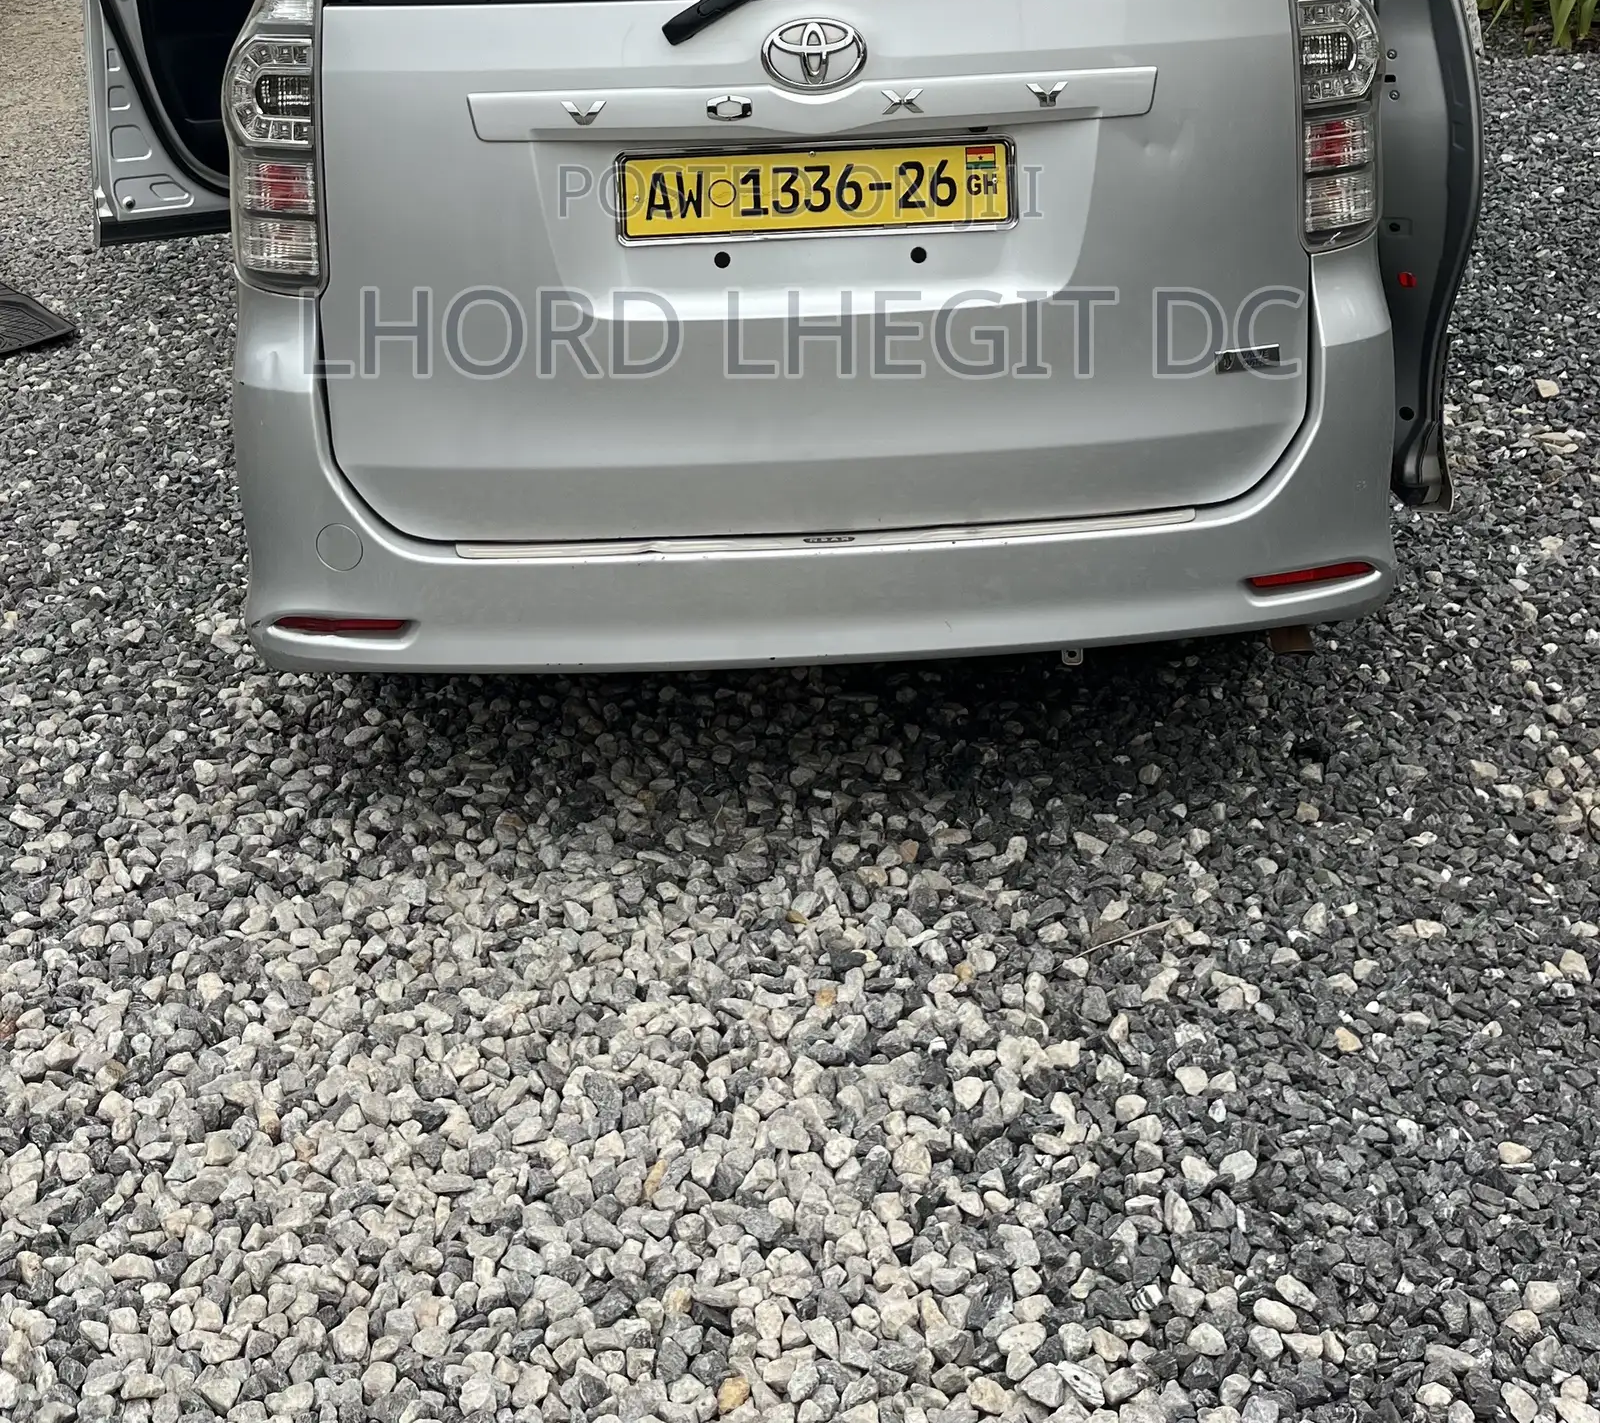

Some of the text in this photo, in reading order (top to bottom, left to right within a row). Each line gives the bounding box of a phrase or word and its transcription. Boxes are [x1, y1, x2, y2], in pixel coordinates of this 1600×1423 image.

[645, 159, 958, 221] AW 1336-26
[966, 173, 998, 196] GH
